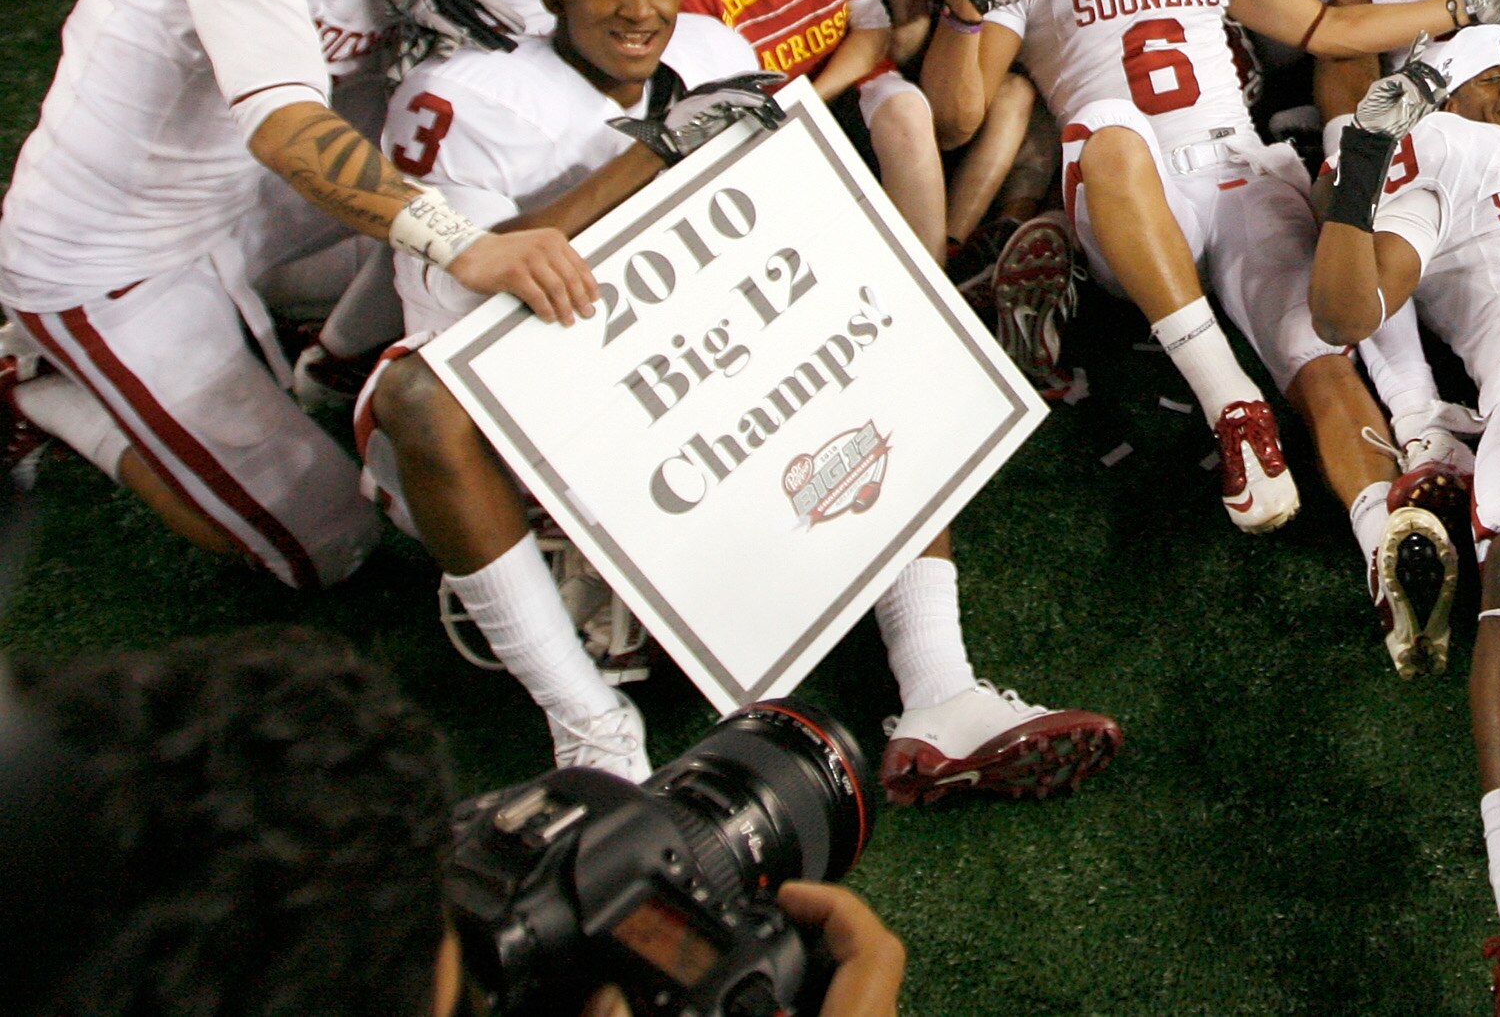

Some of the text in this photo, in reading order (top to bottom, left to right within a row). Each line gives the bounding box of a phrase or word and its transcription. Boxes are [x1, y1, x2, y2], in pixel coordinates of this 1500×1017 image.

[1122, 18, 1201, 113] 6
[393, 90, 454, 176] 3
[602, 187, 757, 348] 2010
[616, 247, 818, 428] Big 12
[649, 285, 893, 516] Champs!
[793, 420, 880, 515] BIG 12
